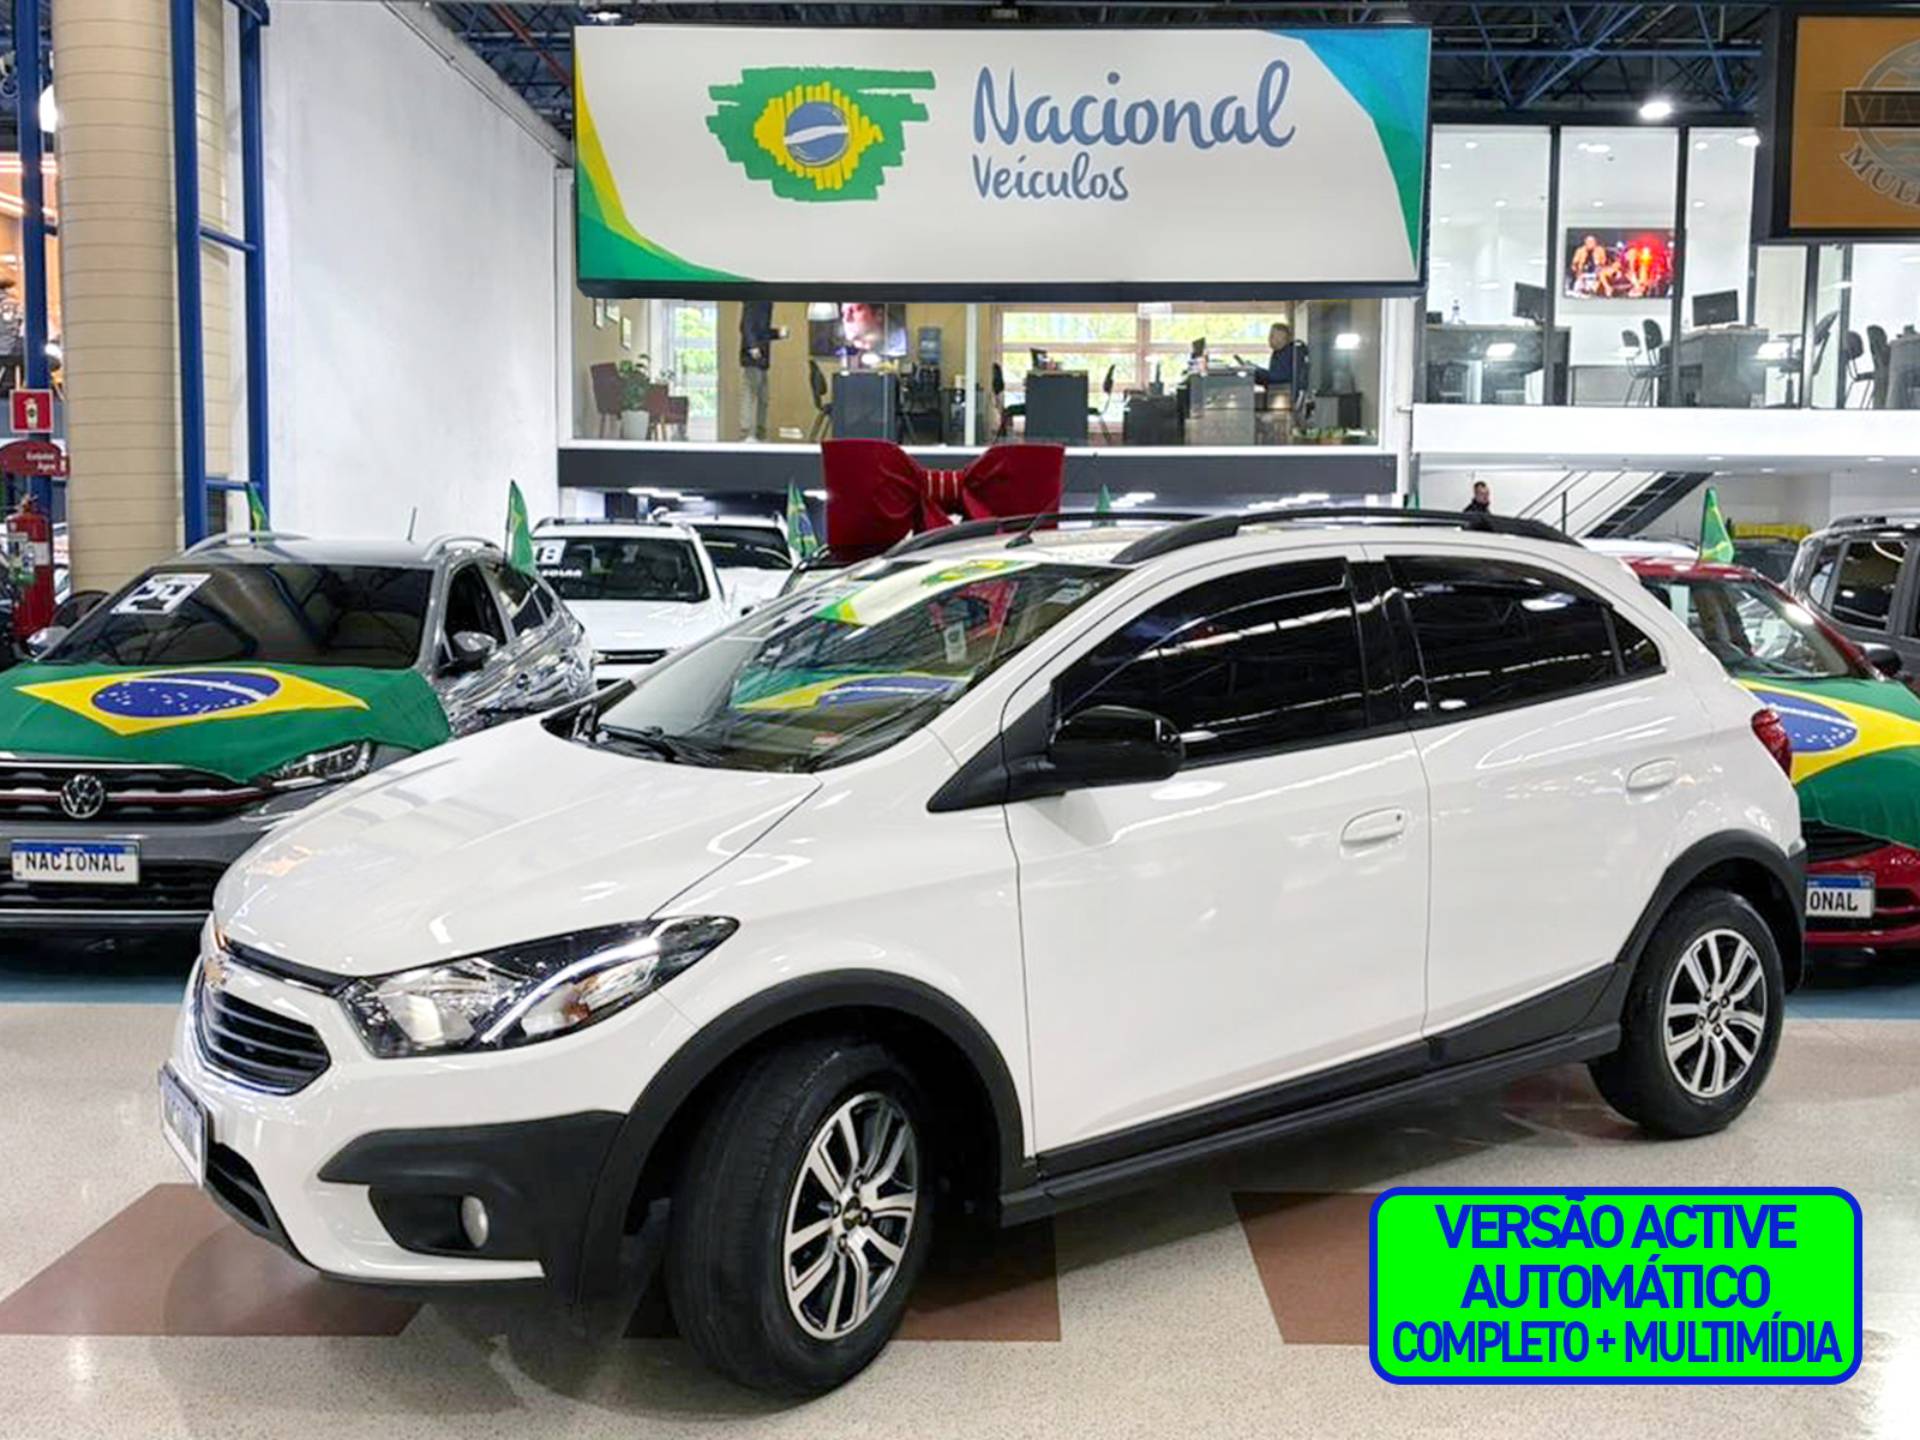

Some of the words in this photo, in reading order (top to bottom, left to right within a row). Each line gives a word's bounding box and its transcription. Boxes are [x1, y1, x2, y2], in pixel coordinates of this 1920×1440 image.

[973, 60, 1296, 149] Nacional
[972, 151, 1129, 201] Veículos
[1845, 146, 1920, 205] MUL
[25, 851, 125, 872] NACIONAL
